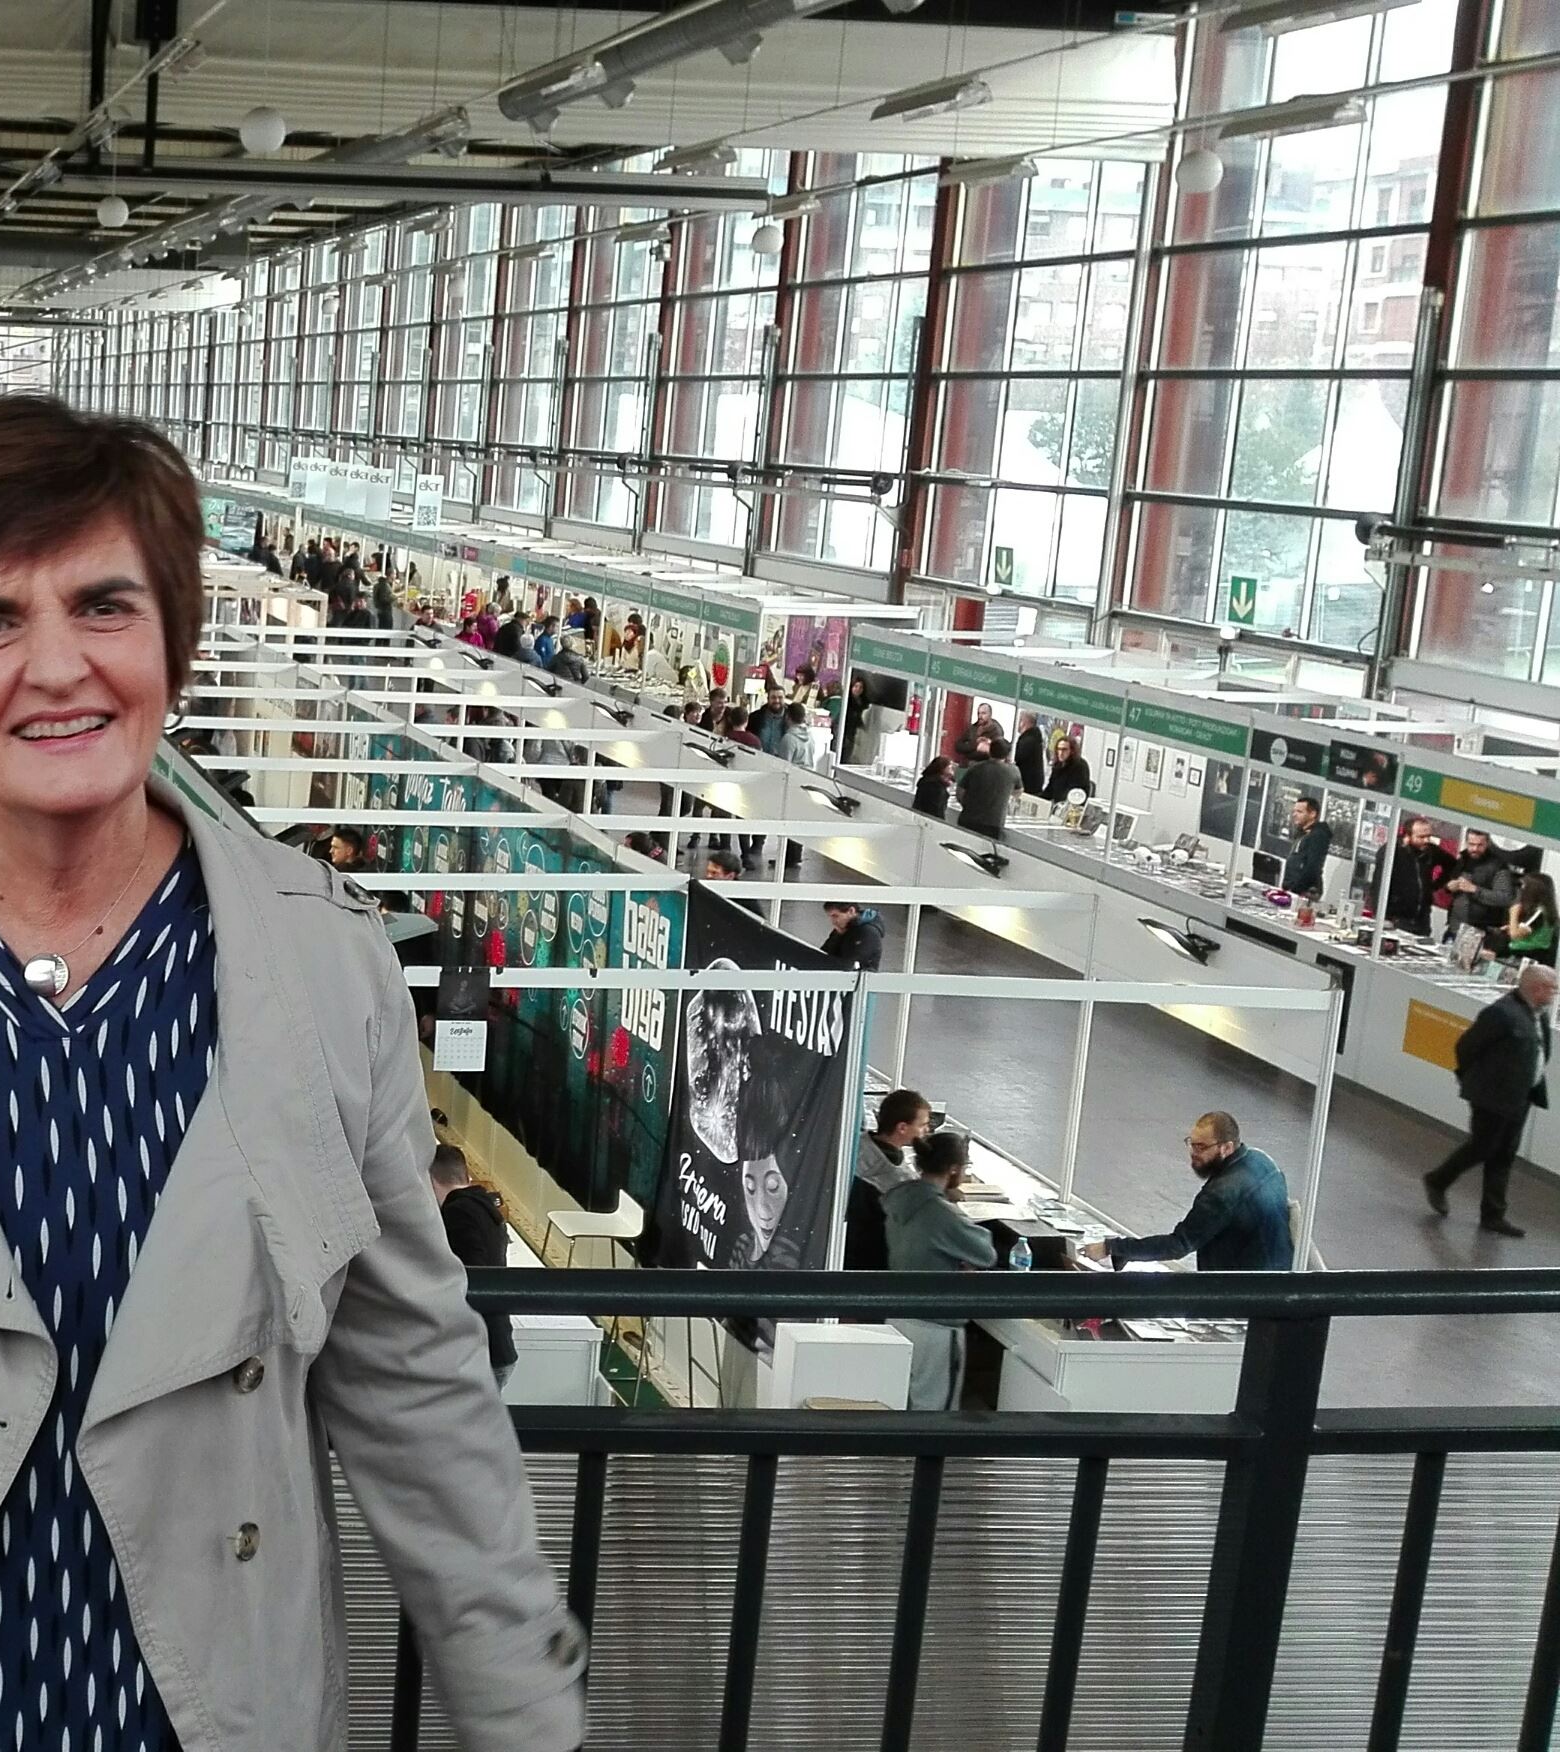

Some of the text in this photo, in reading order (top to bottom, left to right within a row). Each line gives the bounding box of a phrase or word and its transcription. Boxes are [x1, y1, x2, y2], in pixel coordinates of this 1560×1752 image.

[1128, 707, 1142, 722] 47
[1405, 774, 1423, 793] 49
[623, 891, 671, 970] baga
